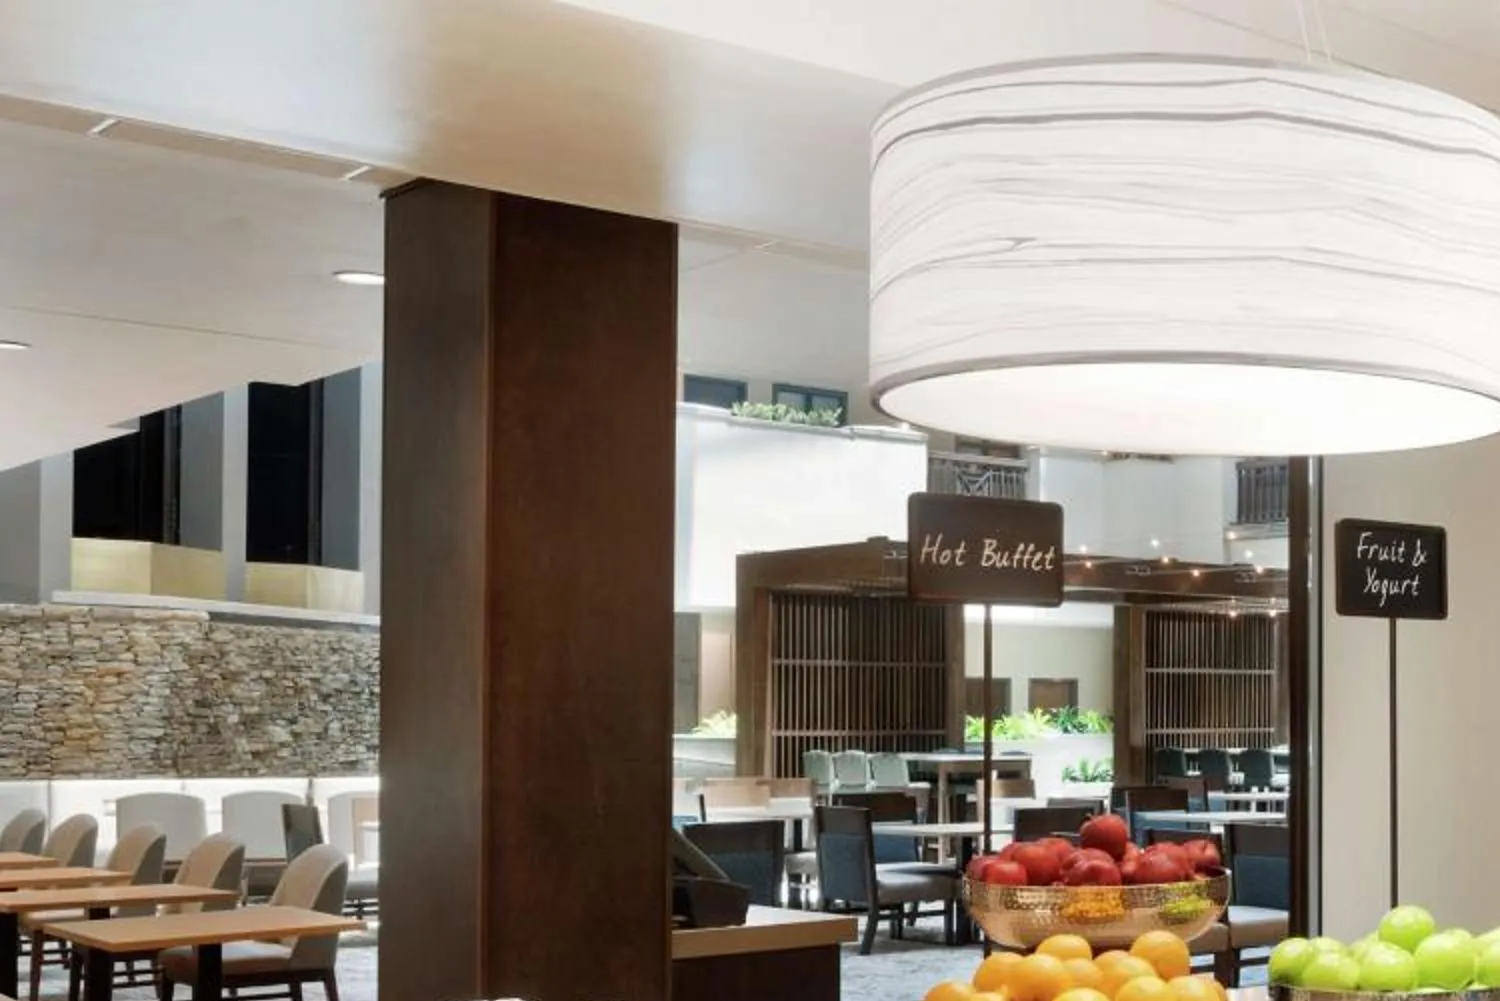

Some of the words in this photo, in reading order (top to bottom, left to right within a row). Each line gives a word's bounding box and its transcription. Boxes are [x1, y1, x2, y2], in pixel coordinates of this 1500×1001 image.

[919, 533, 966, 566] Hot
[981, 538, 1055, 571] Buffet
[1357, 531, 1405, 563] Fruit
[1363, 566, 1420, 608] Yogurt
